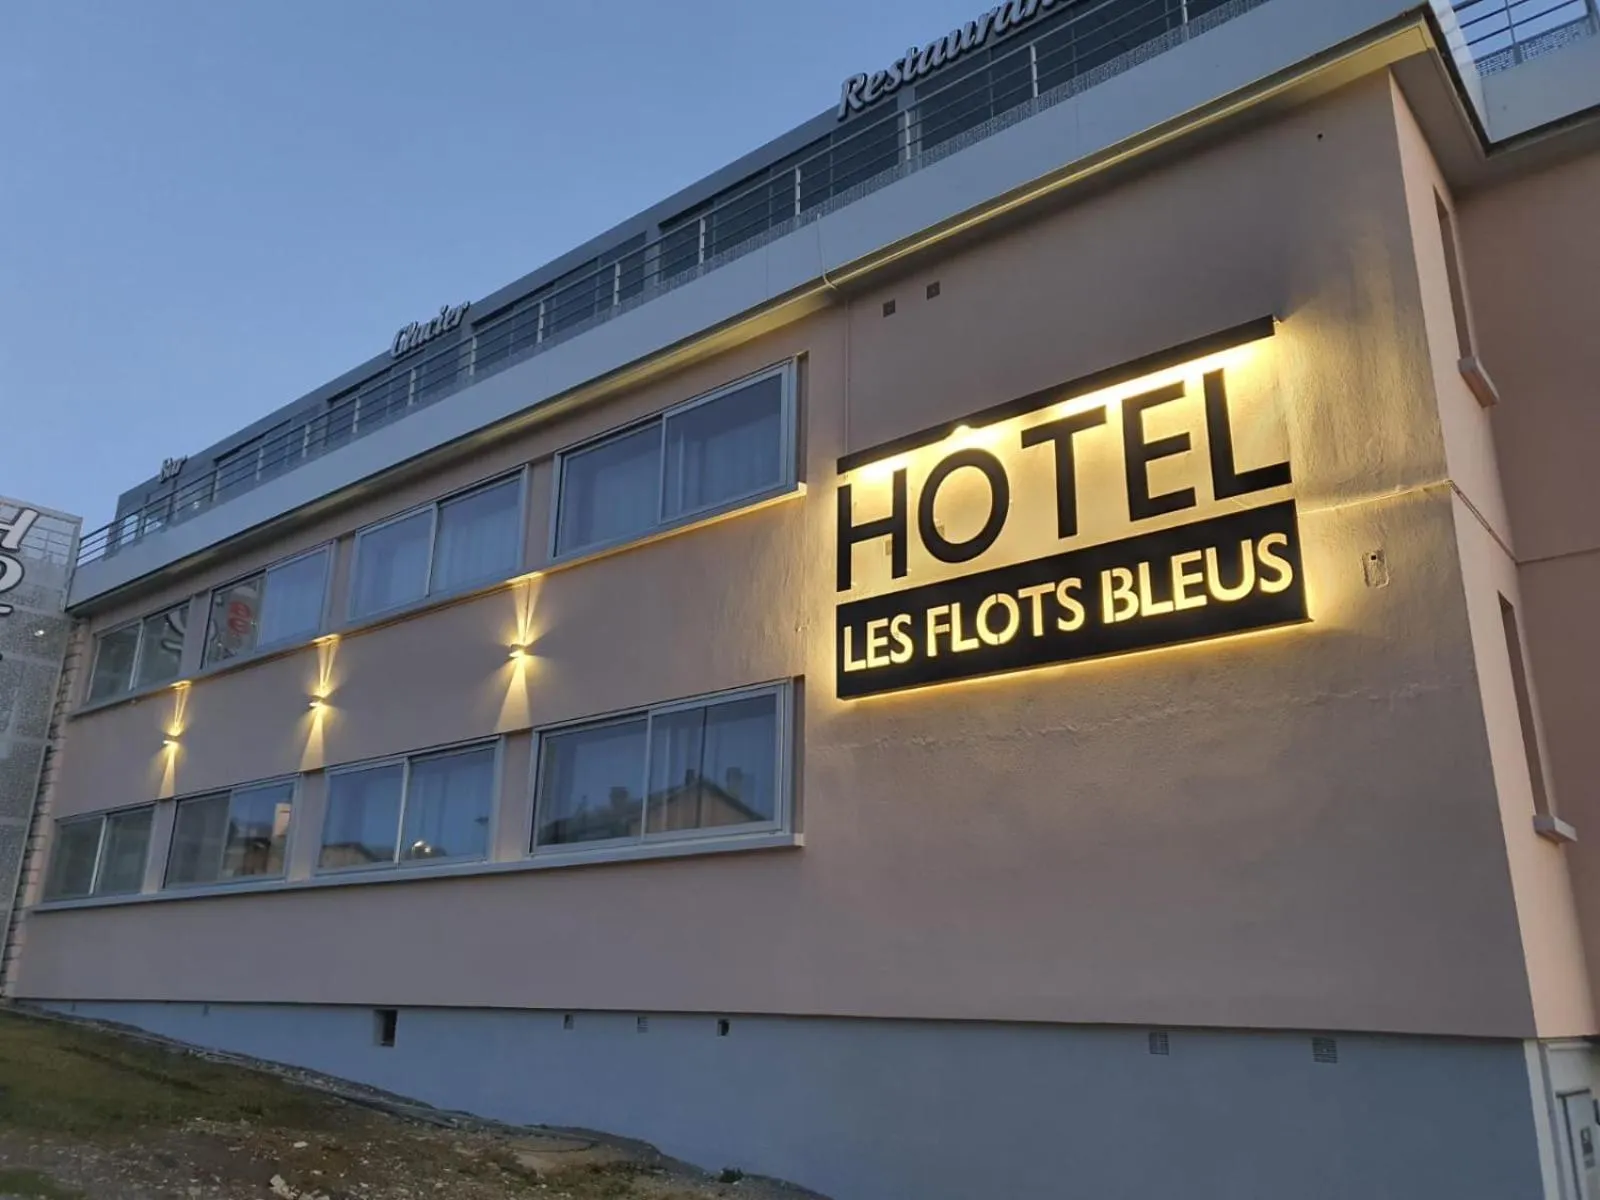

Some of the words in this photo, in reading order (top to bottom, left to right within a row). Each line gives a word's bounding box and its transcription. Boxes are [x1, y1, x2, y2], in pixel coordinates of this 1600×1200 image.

[391, 301, 470, 358] Glacier
[843, 614, 913, 672] LES
[926, 577, 1085, 658] FLOTS
[1100, 533, 1293, 625] BLEUS
